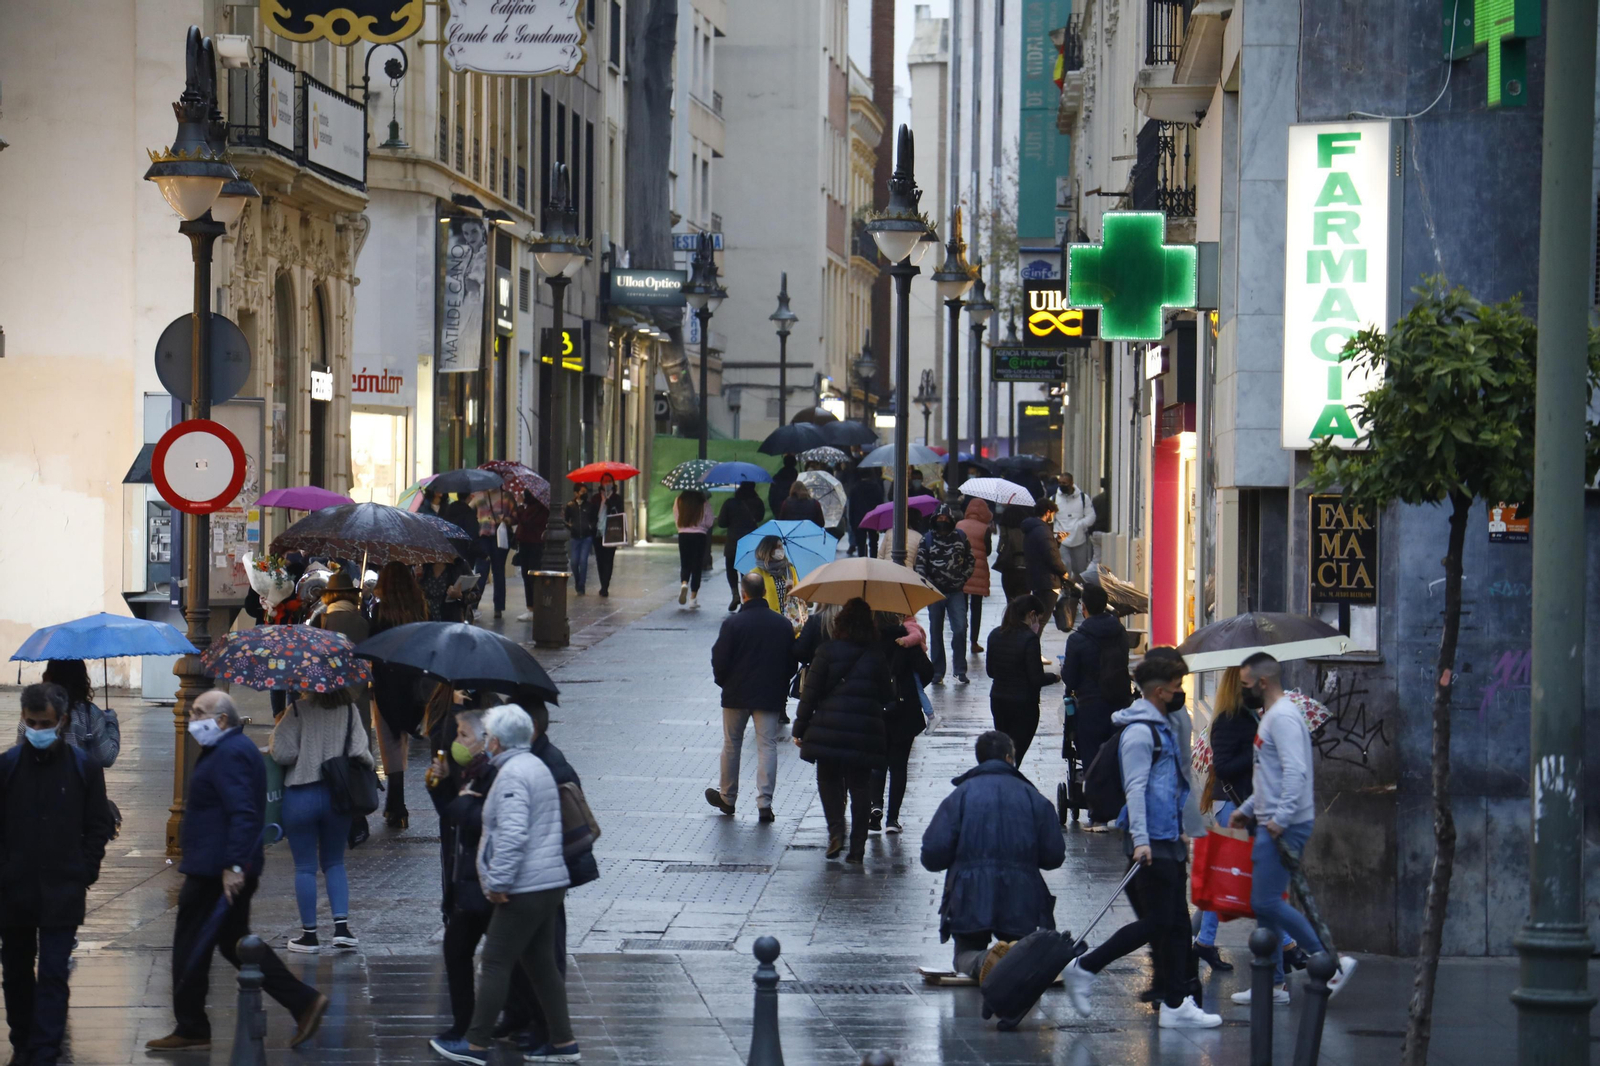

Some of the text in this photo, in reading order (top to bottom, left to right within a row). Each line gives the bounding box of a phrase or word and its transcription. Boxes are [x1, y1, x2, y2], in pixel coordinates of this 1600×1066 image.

[449, 23, 578, 43] Conde de Gondomar
[1026, 90, 1043, 107] DE
[616, 275, 681, 291] Ulloa Optico
[1306, 132, 1367, 438] FARMACIA
[446, 244, 464, 363] MATILDE CANO
[1319, 532, 1366, 559] MA
[1317, 560, 1374, 588] CIA
